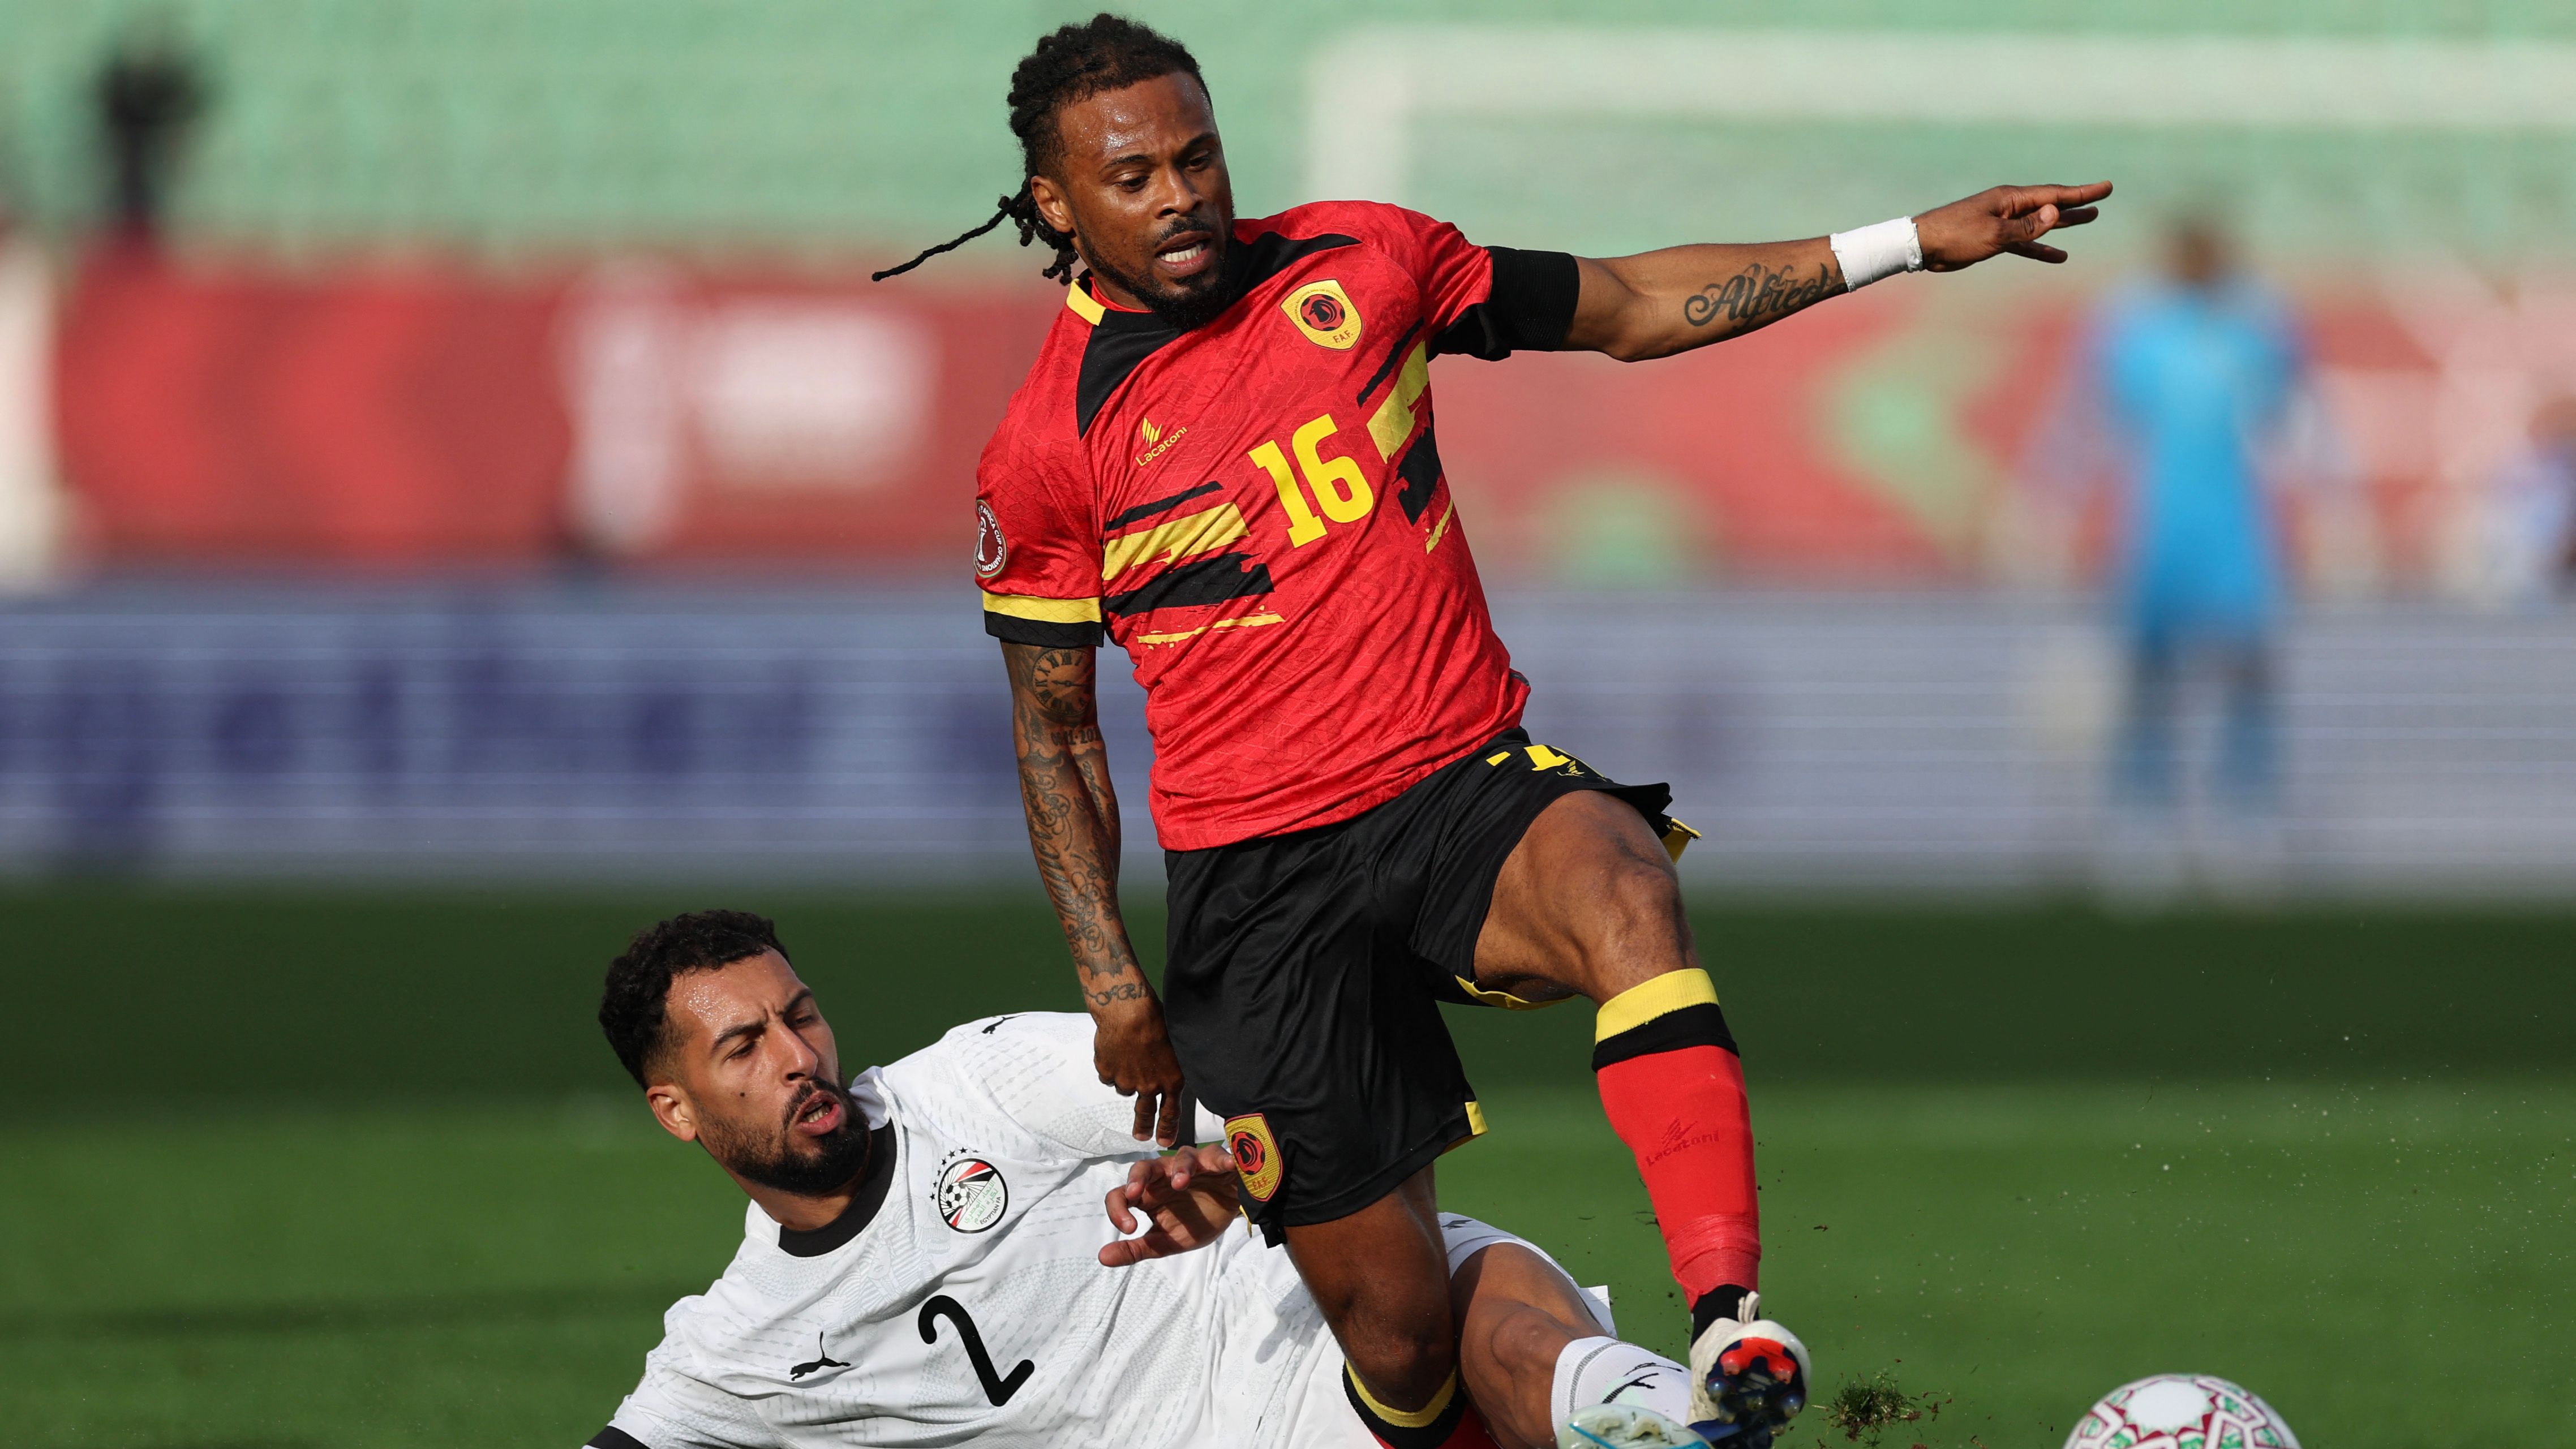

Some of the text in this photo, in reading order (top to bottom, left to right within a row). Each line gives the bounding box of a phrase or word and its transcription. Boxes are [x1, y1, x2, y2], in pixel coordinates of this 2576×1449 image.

[1333, 330, 1353, 343] F.A.F.
[1135, 427, 1187, 466] Lacatoni
[1247, 413, 1374, 548] 16
[983, 508, 995, 529] AFRICA
[998, 546, 1003, 557] OF
[982, 555, 1002, 571] NATIONS
[980, 1204, 999, 1224] EGYPTIAN
[918, 1295, 1035, 1407] 2
